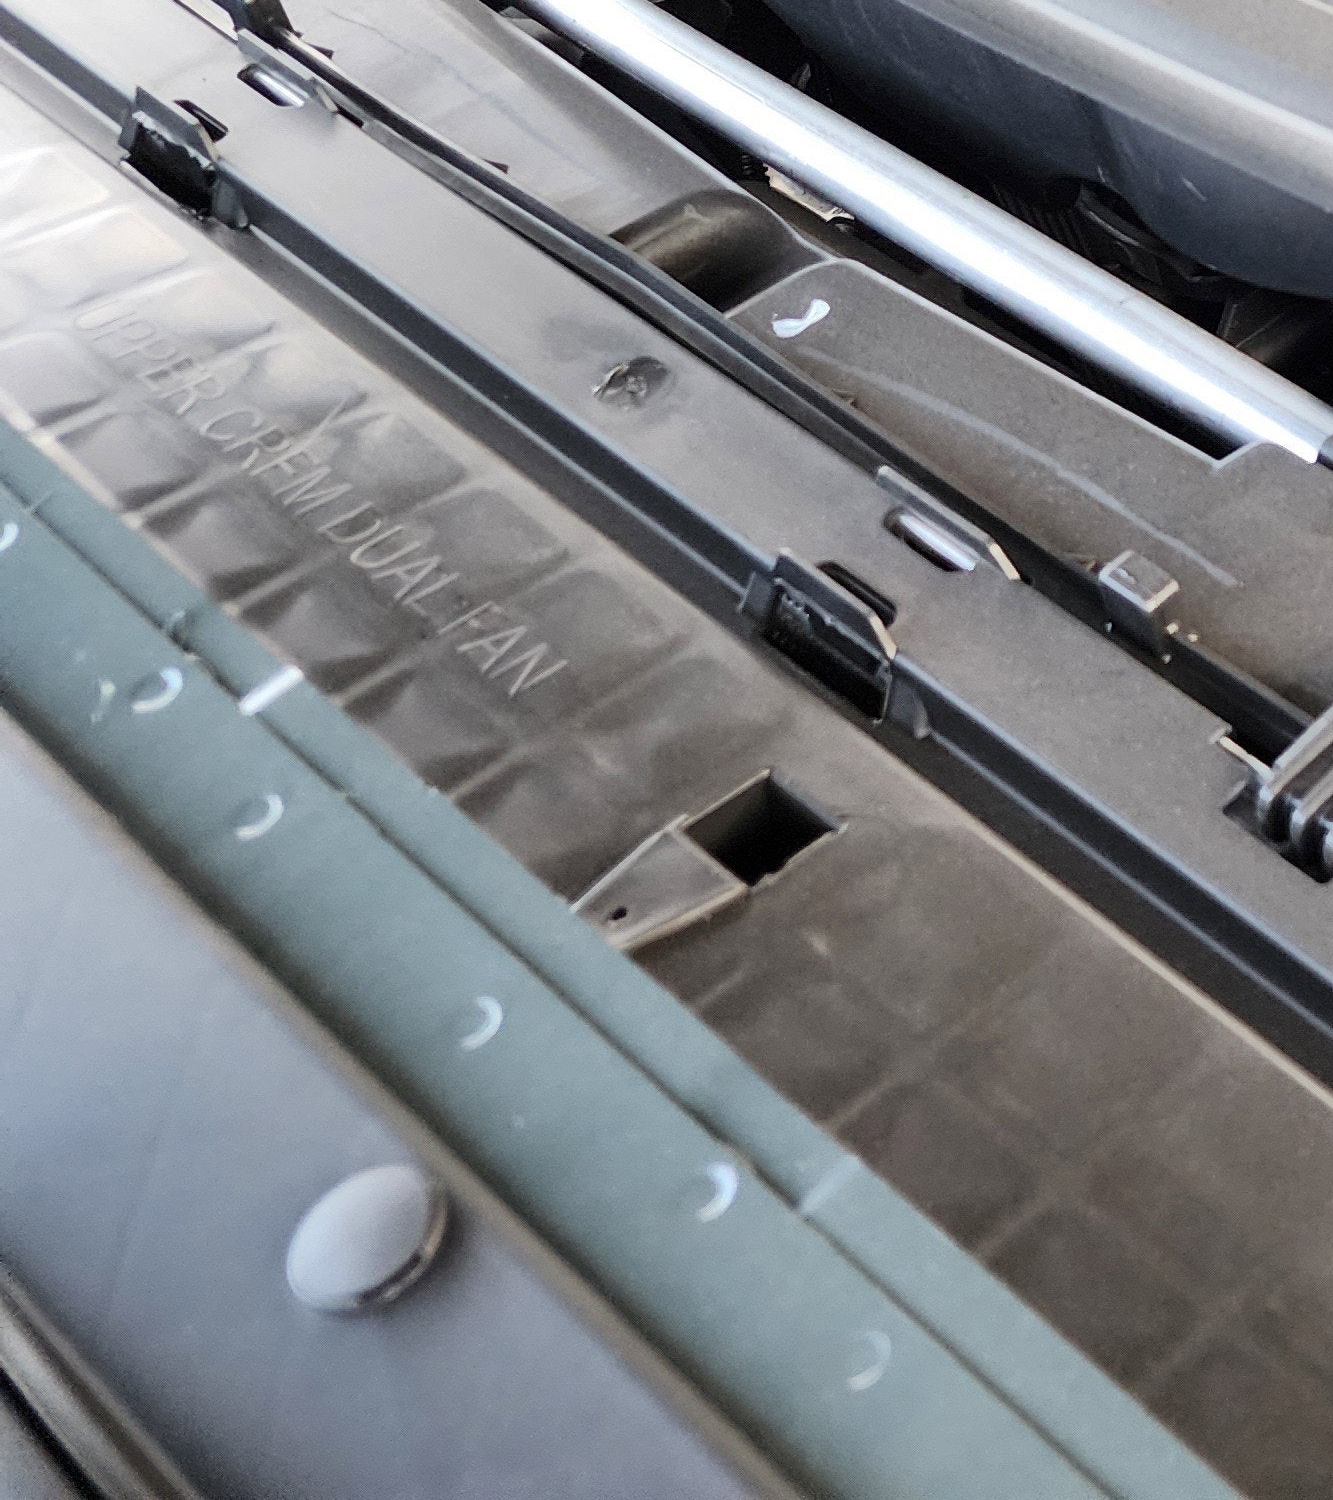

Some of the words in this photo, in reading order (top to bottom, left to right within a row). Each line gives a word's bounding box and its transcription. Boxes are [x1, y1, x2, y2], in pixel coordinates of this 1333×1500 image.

[74, 299, 226, 415] UPPER
[203, 408, 353, 517] CRFM
[317, 501, 461, 617] DUAL
[437, 600, 569, 697] FAN
